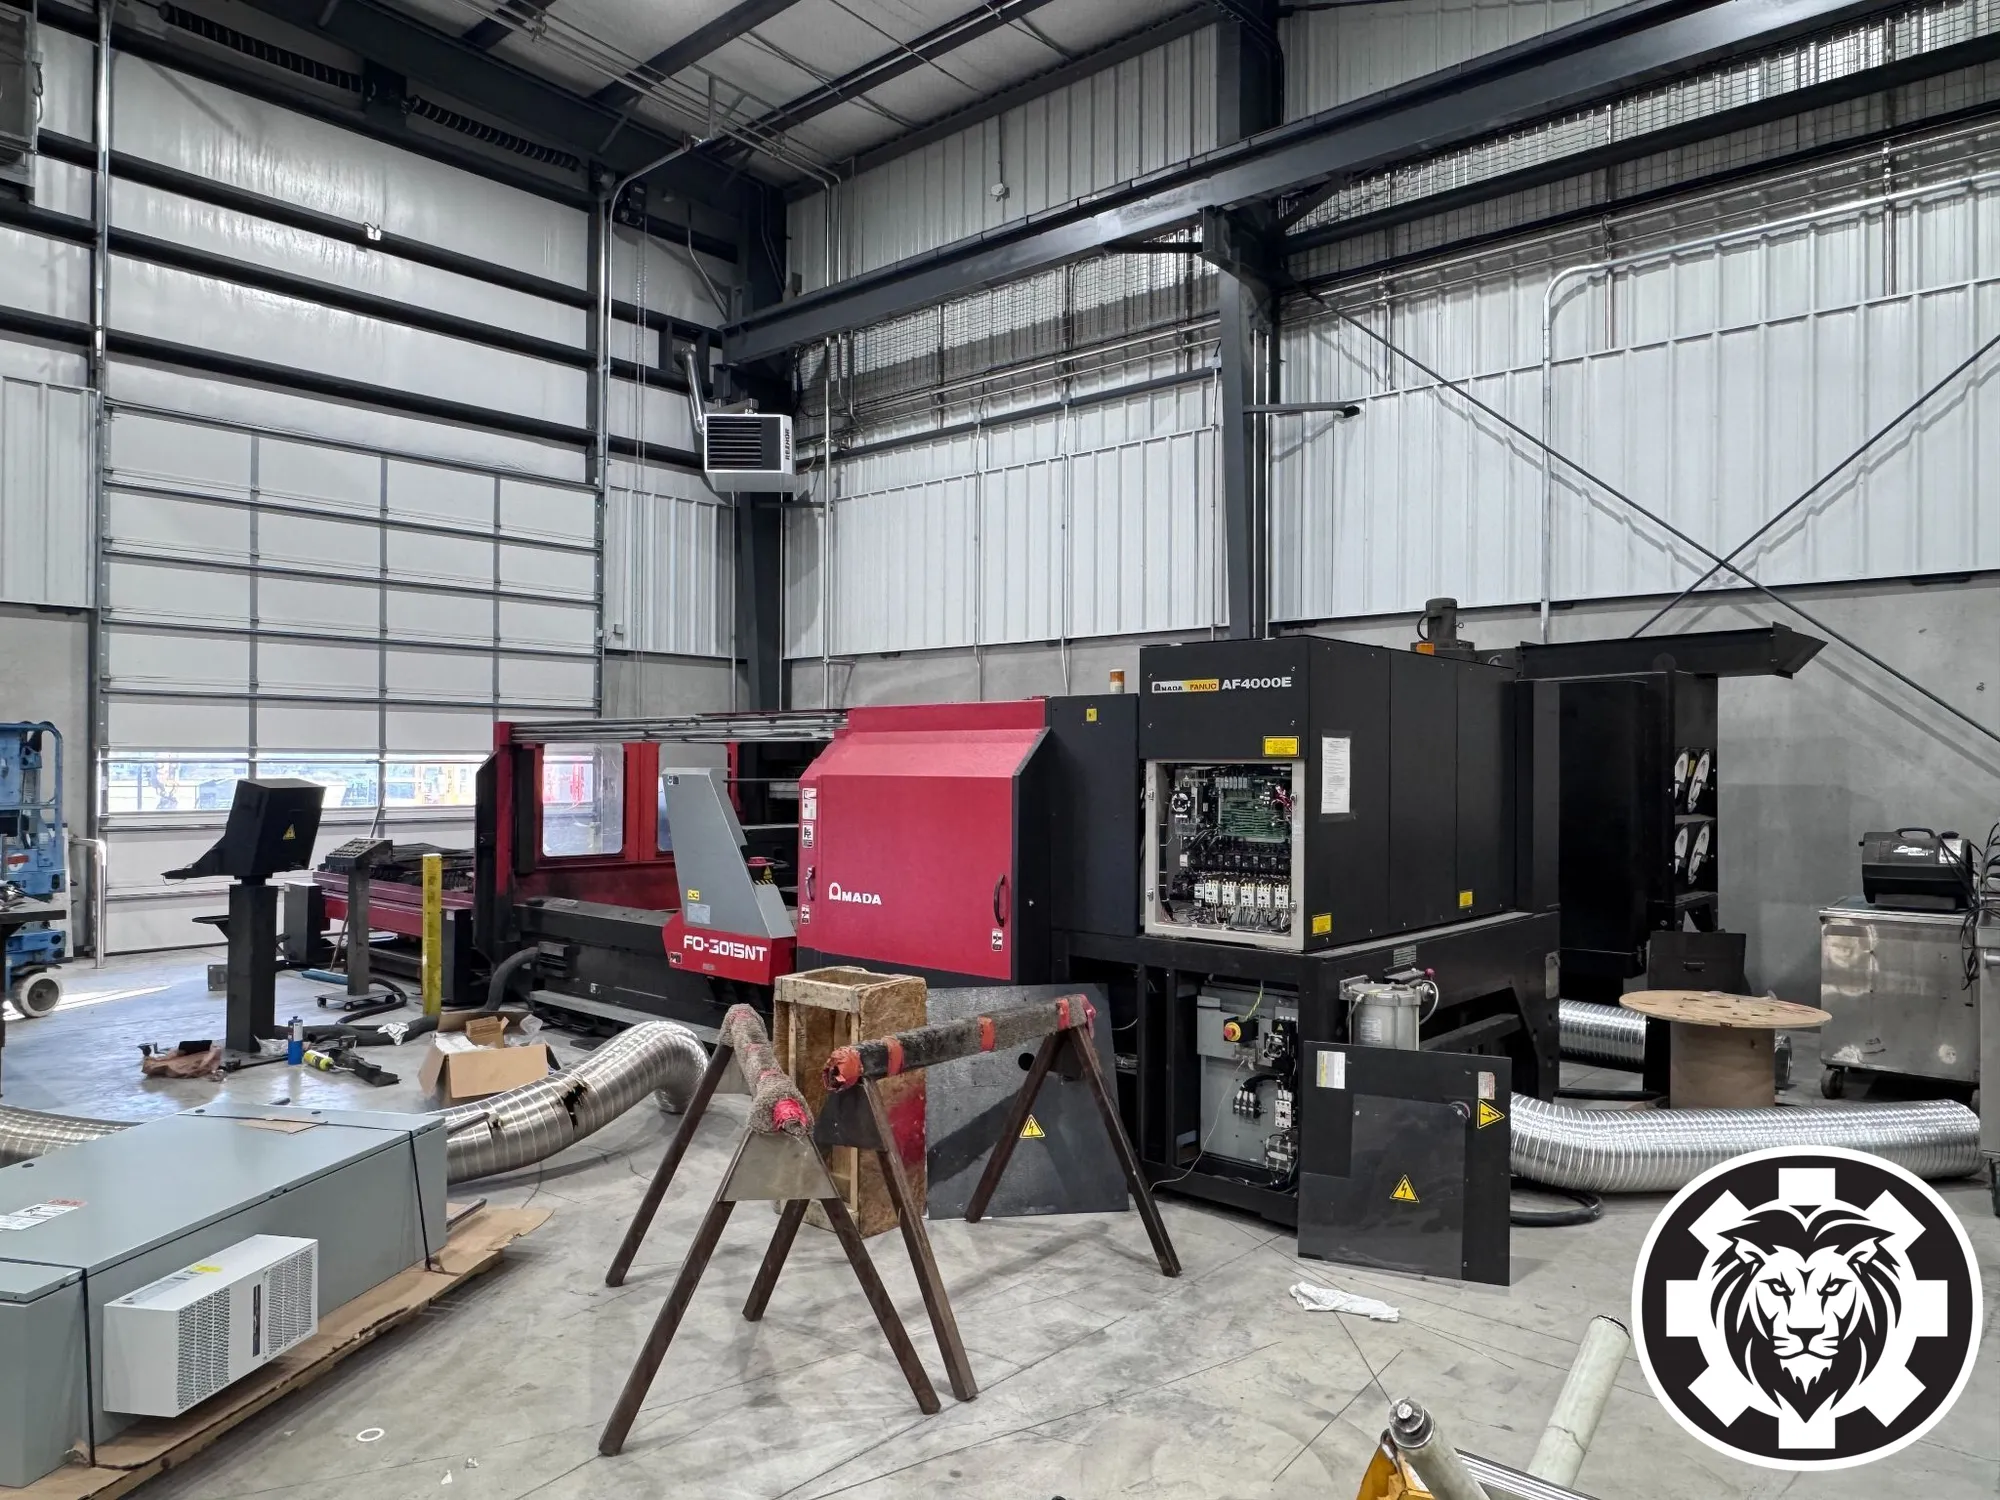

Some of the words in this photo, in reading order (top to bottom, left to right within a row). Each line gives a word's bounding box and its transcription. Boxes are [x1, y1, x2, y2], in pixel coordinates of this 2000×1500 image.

[1154, 683, 1183, 692] AMADA
[1189, 682, 1217, 691] FANUC
[1221, 676, 1292, 690] AF4000E
[828, 882, 882, 906] AMADA
[683, 934, 768, 962] FO-3015NT
